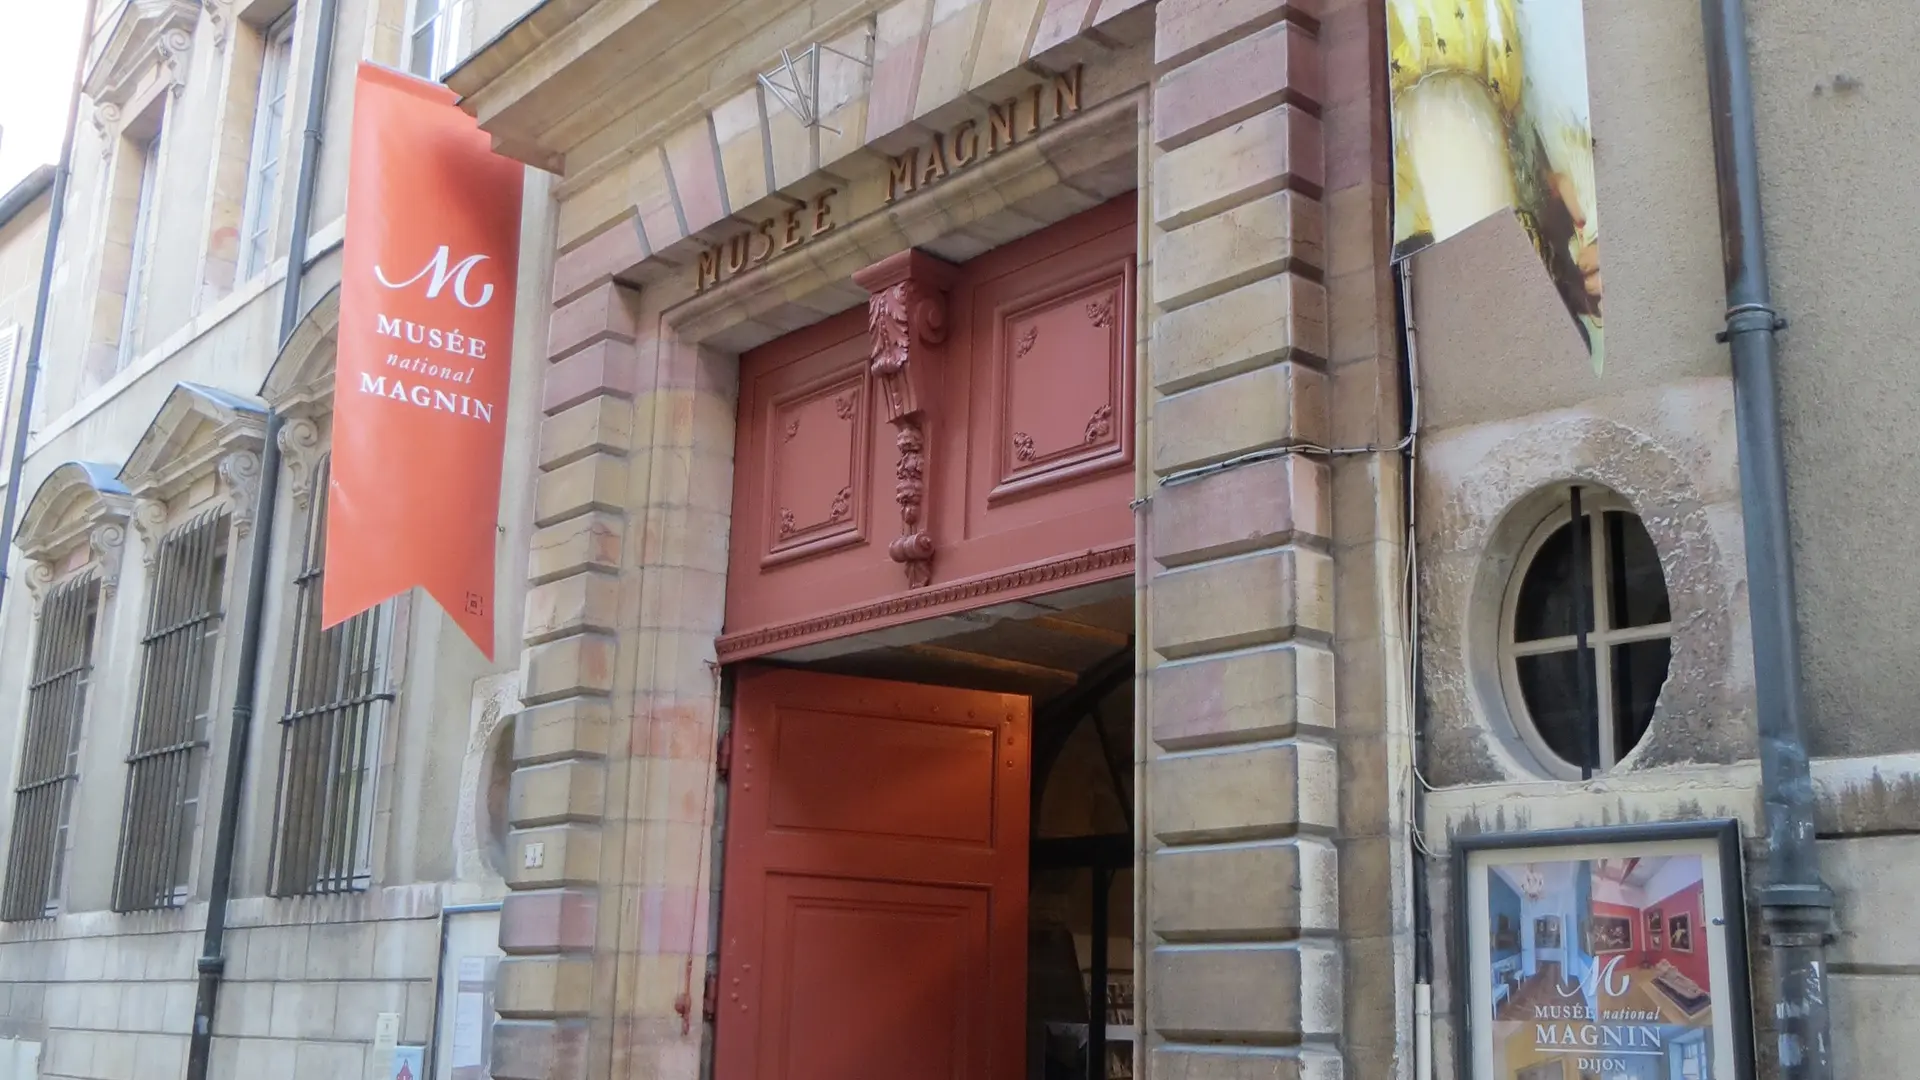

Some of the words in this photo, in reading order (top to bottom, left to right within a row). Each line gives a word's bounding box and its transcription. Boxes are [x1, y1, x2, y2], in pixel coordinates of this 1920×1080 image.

[884, 61, 1084, 204] MAGNIN
[376, 313, 487, 359] MUSÉE
[386, 353, 475, 384] national
[359, 371, 494, 423] MAGNIN
[1534, 1002, 1596, 1020] MUSÉE
[1602, 1006, 1661, 1021] national
[1535, 1023, 1661, 1048] MAGNIN
[1577, 1057, 1626, 1074] DIJON
